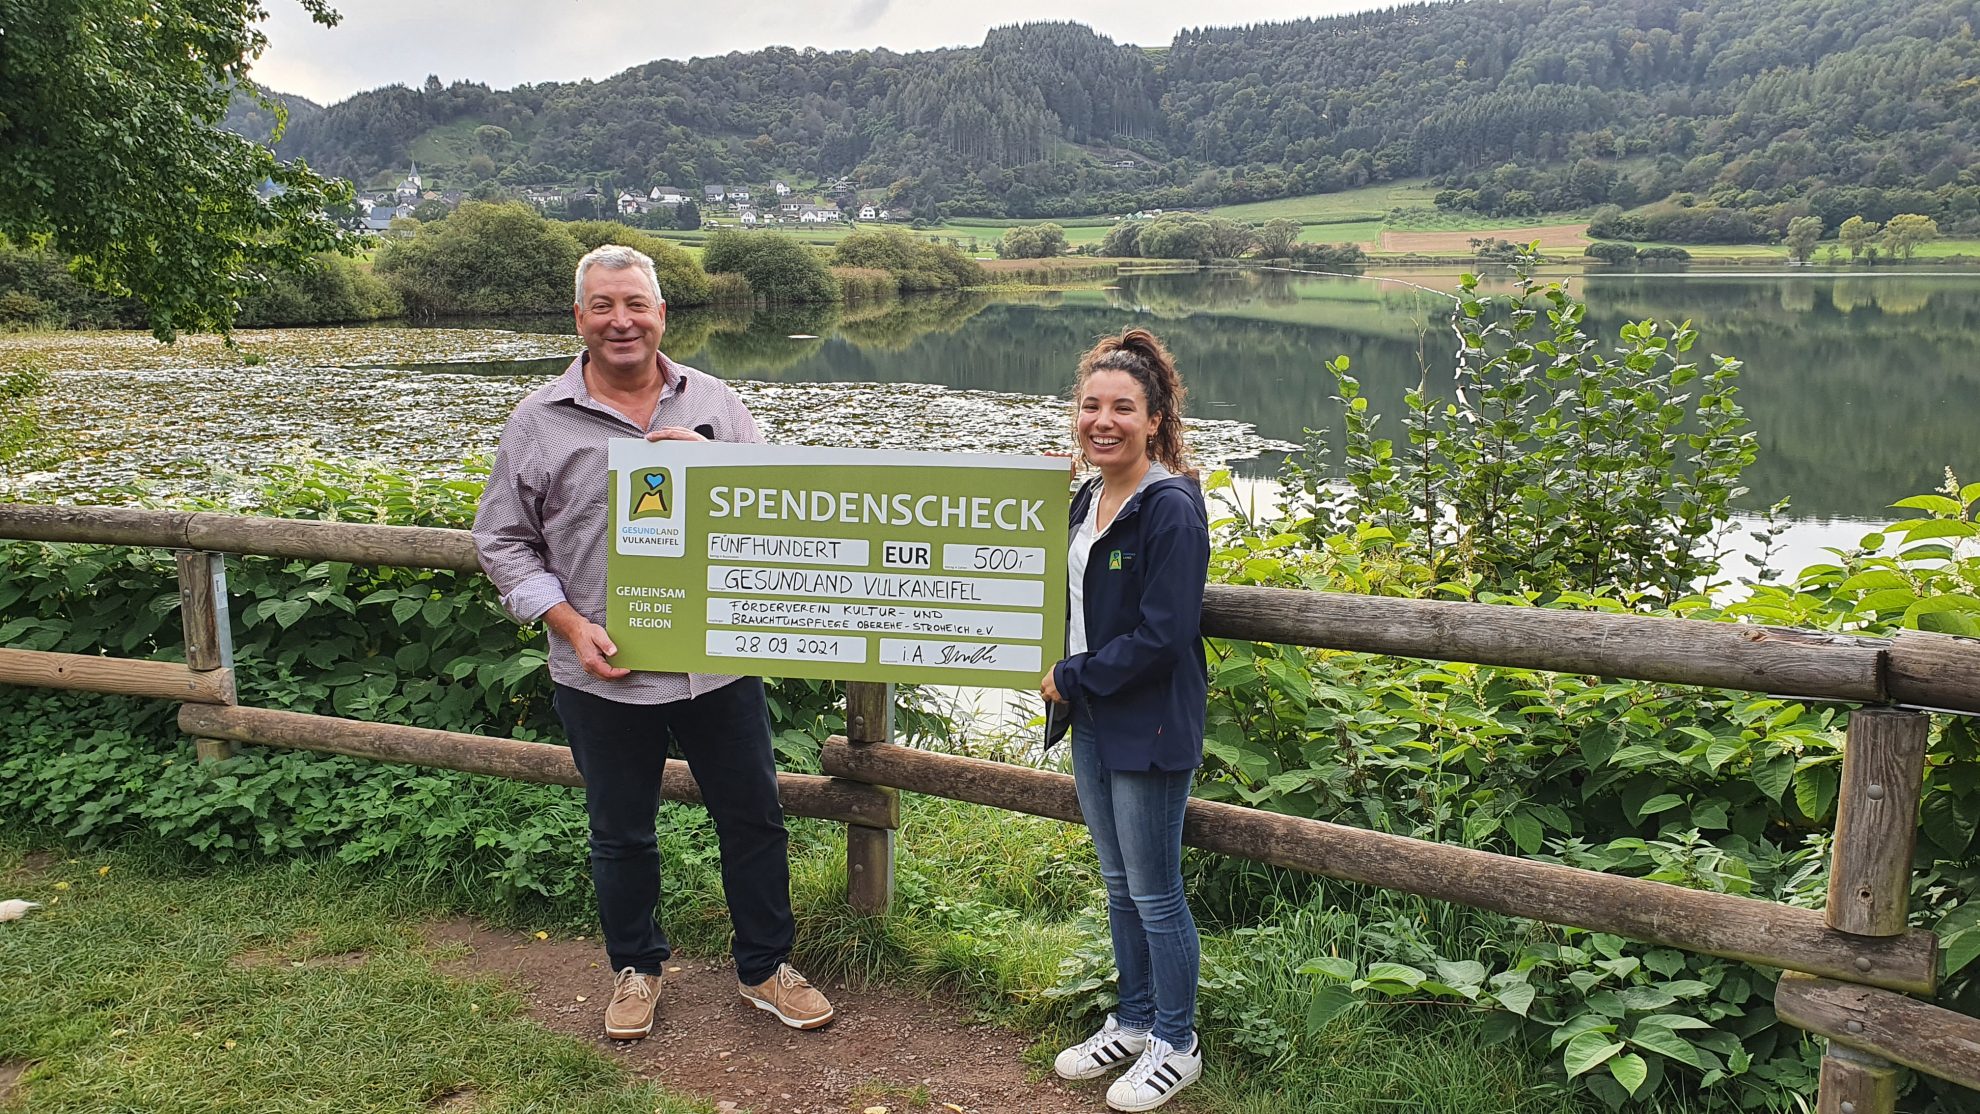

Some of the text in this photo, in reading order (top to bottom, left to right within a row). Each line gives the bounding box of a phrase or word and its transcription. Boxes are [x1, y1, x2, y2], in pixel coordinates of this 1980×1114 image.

[709, 486, 1045, 531] SPENDENSCHECK
[622, 526, 679, 536] GESUNDLAND
[622, 536, 679, 546] VULKANEIFEL
[885, 546, 929, 565] EUR
[724, 569, 981, 601] GESUNDLAND VULKANEIFEL
[616, 586, 686, 599] GEMEINSAM
[629, 600, 672, 613] FÜR DIE
[729, 601, 943, 619] FÖRDERVEREIN KULTUR- UND
[629, 617, 672, 628] REGION
[731, 613, 850, 629] BRAUCHTUMSPFLEGE
